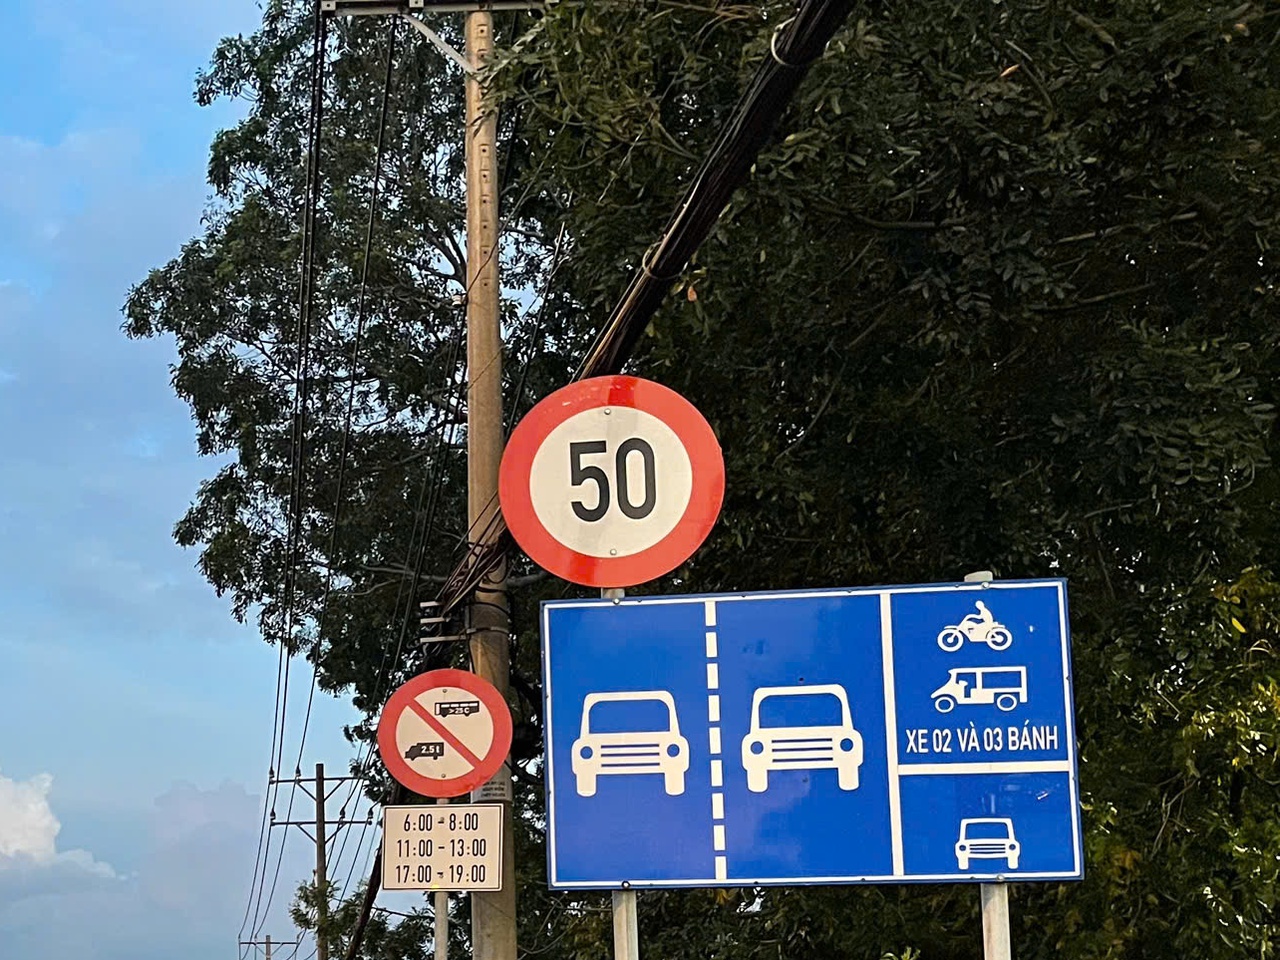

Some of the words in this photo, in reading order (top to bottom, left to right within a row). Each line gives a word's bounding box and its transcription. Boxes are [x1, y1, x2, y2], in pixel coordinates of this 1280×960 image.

[568, 437, 657, 523] 50
[905, 729, 929, 753] XE
[932, 728, 952, 753] 02
[956, 721, 981, 752] VÀ
[983, 727, 1003, 751] 03
[1007, 719, 1058, 751] BÁNH
[403, 813, 433, 832] 6:00
[449, 813, 478, 831] 8:00
[396, 839, 433, 857] 11:00
[450, 838, 486, 857] 13:00
[395, 865, 432, 883] 17:00
[449, 864, 486, 883] 19:00
